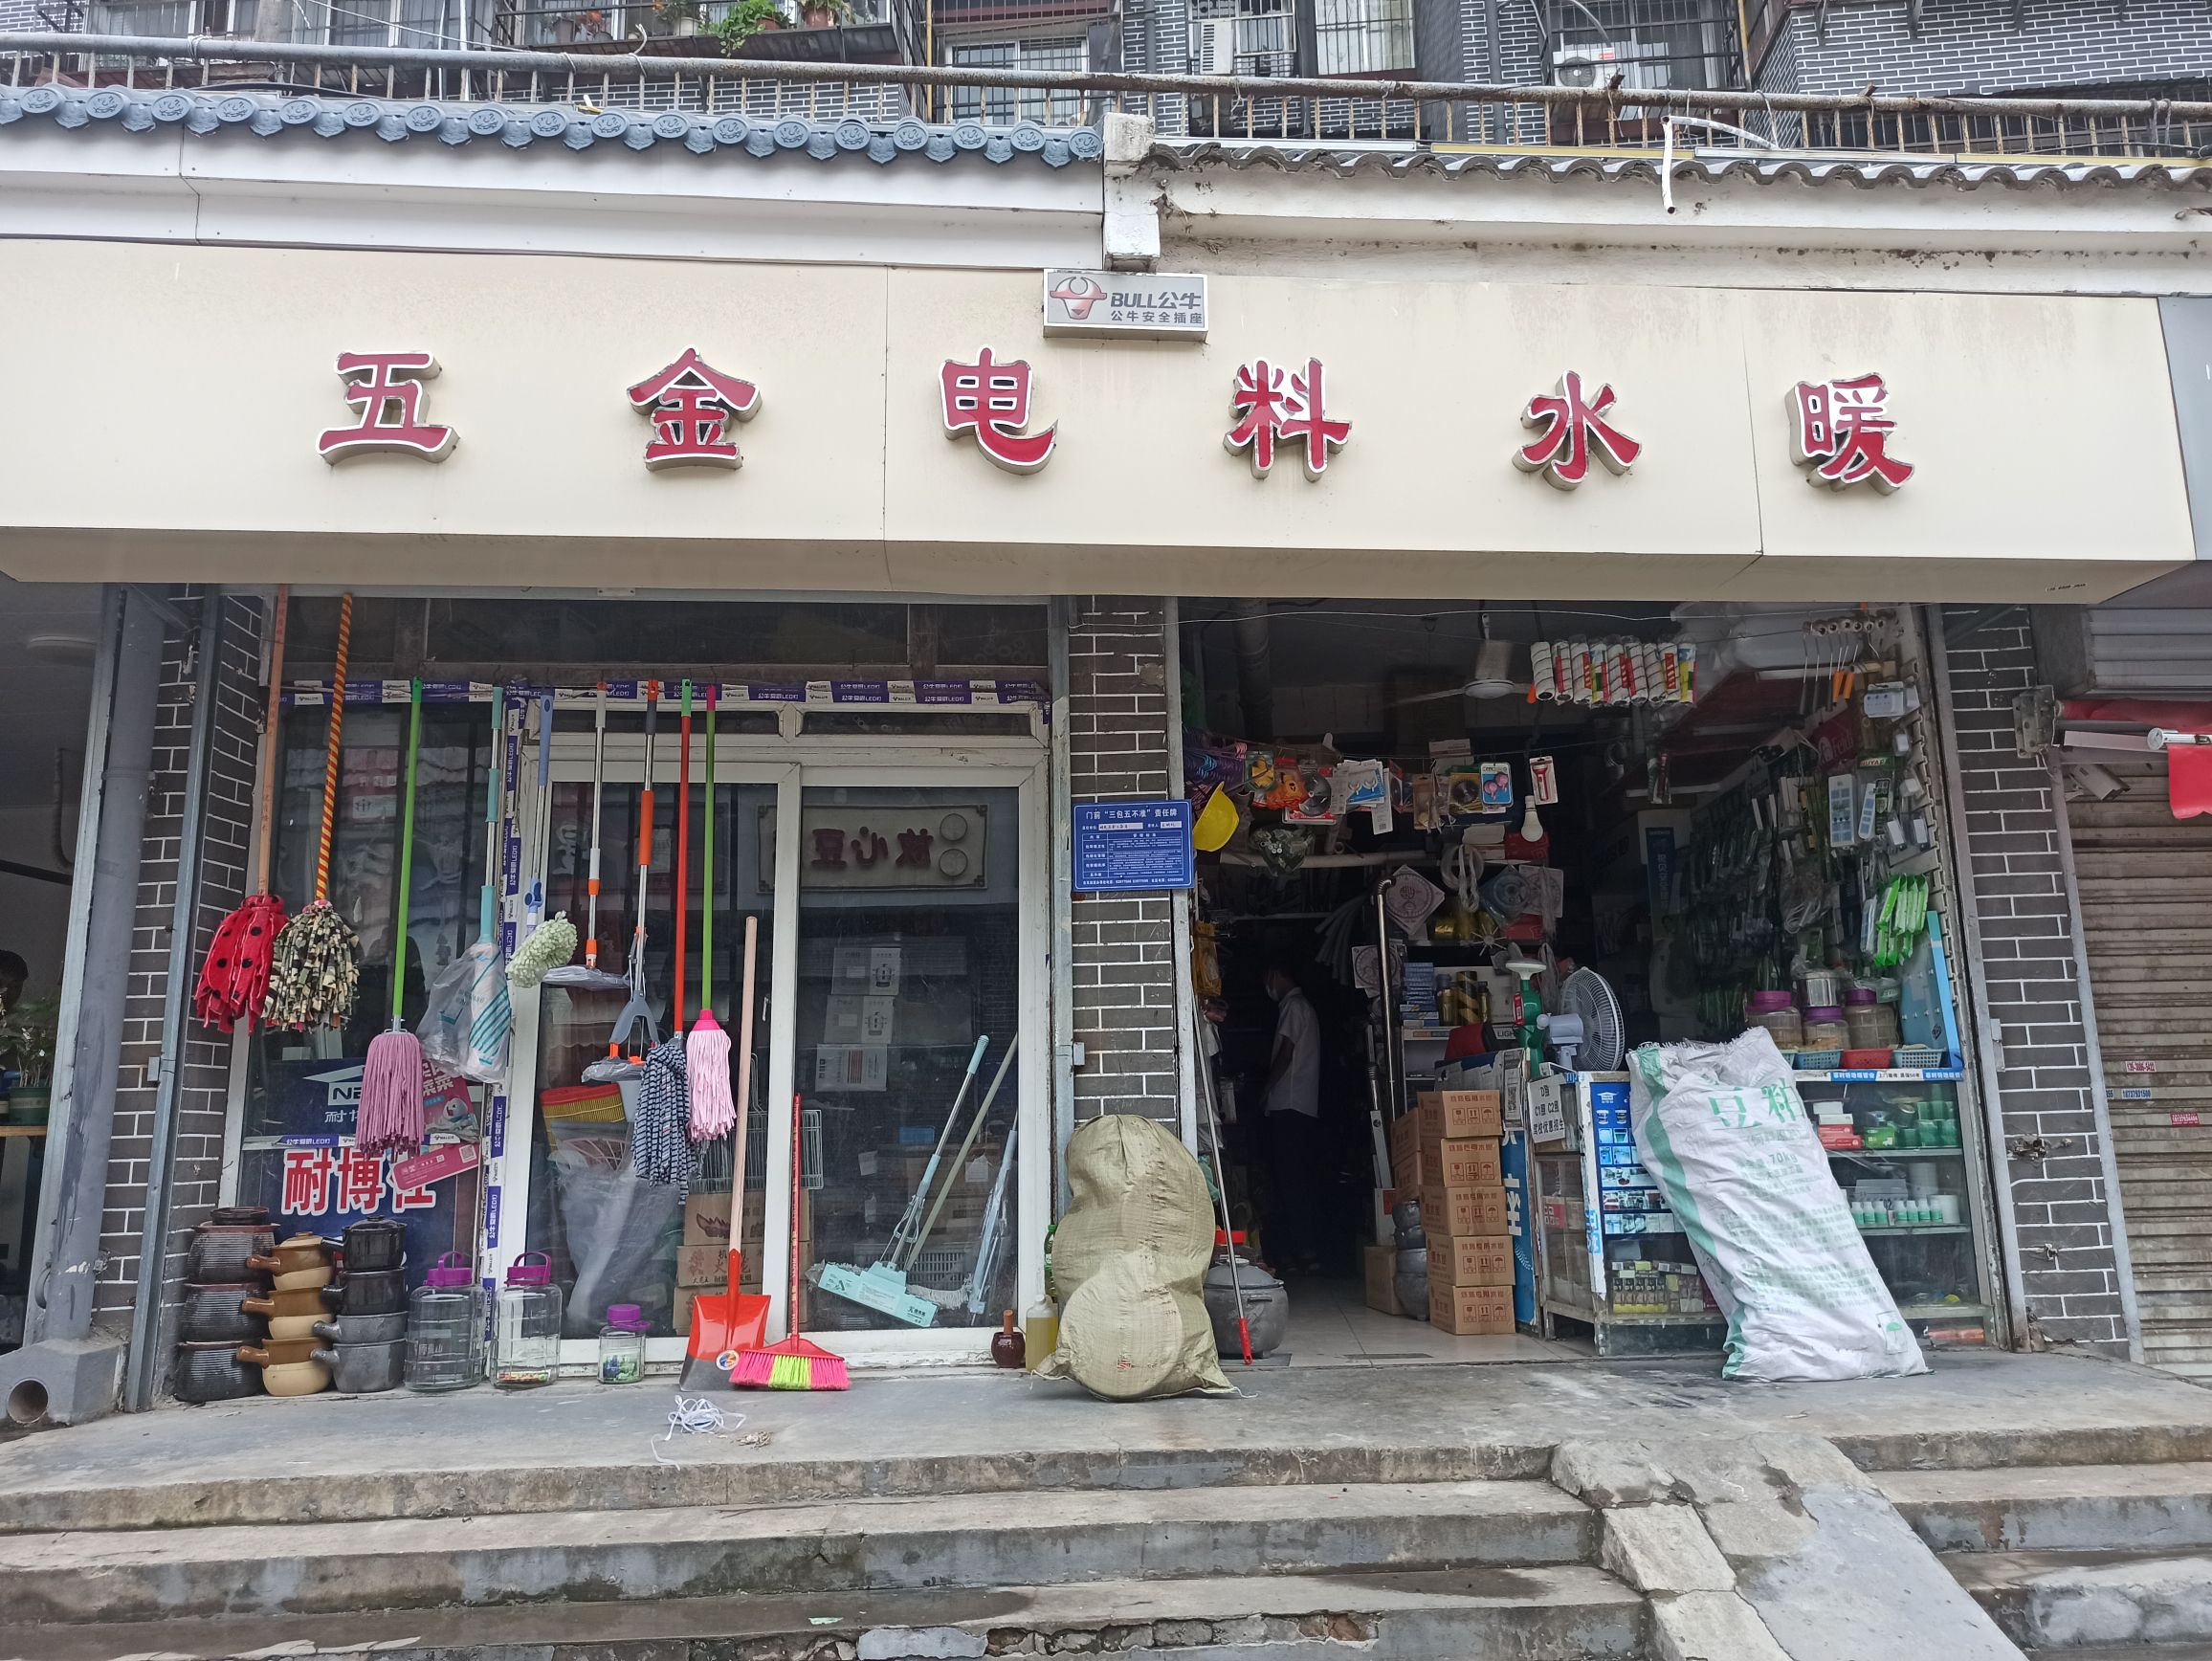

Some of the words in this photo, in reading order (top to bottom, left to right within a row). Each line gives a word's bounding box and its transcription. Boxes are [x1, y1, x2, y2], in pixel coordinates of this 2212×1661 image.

[1110, 291, 1203, 310] BULL公牛
[1110, 310, 1203, 324] 公牛安全插座
[316, 344, 1914, 495] 五金电料水暖
